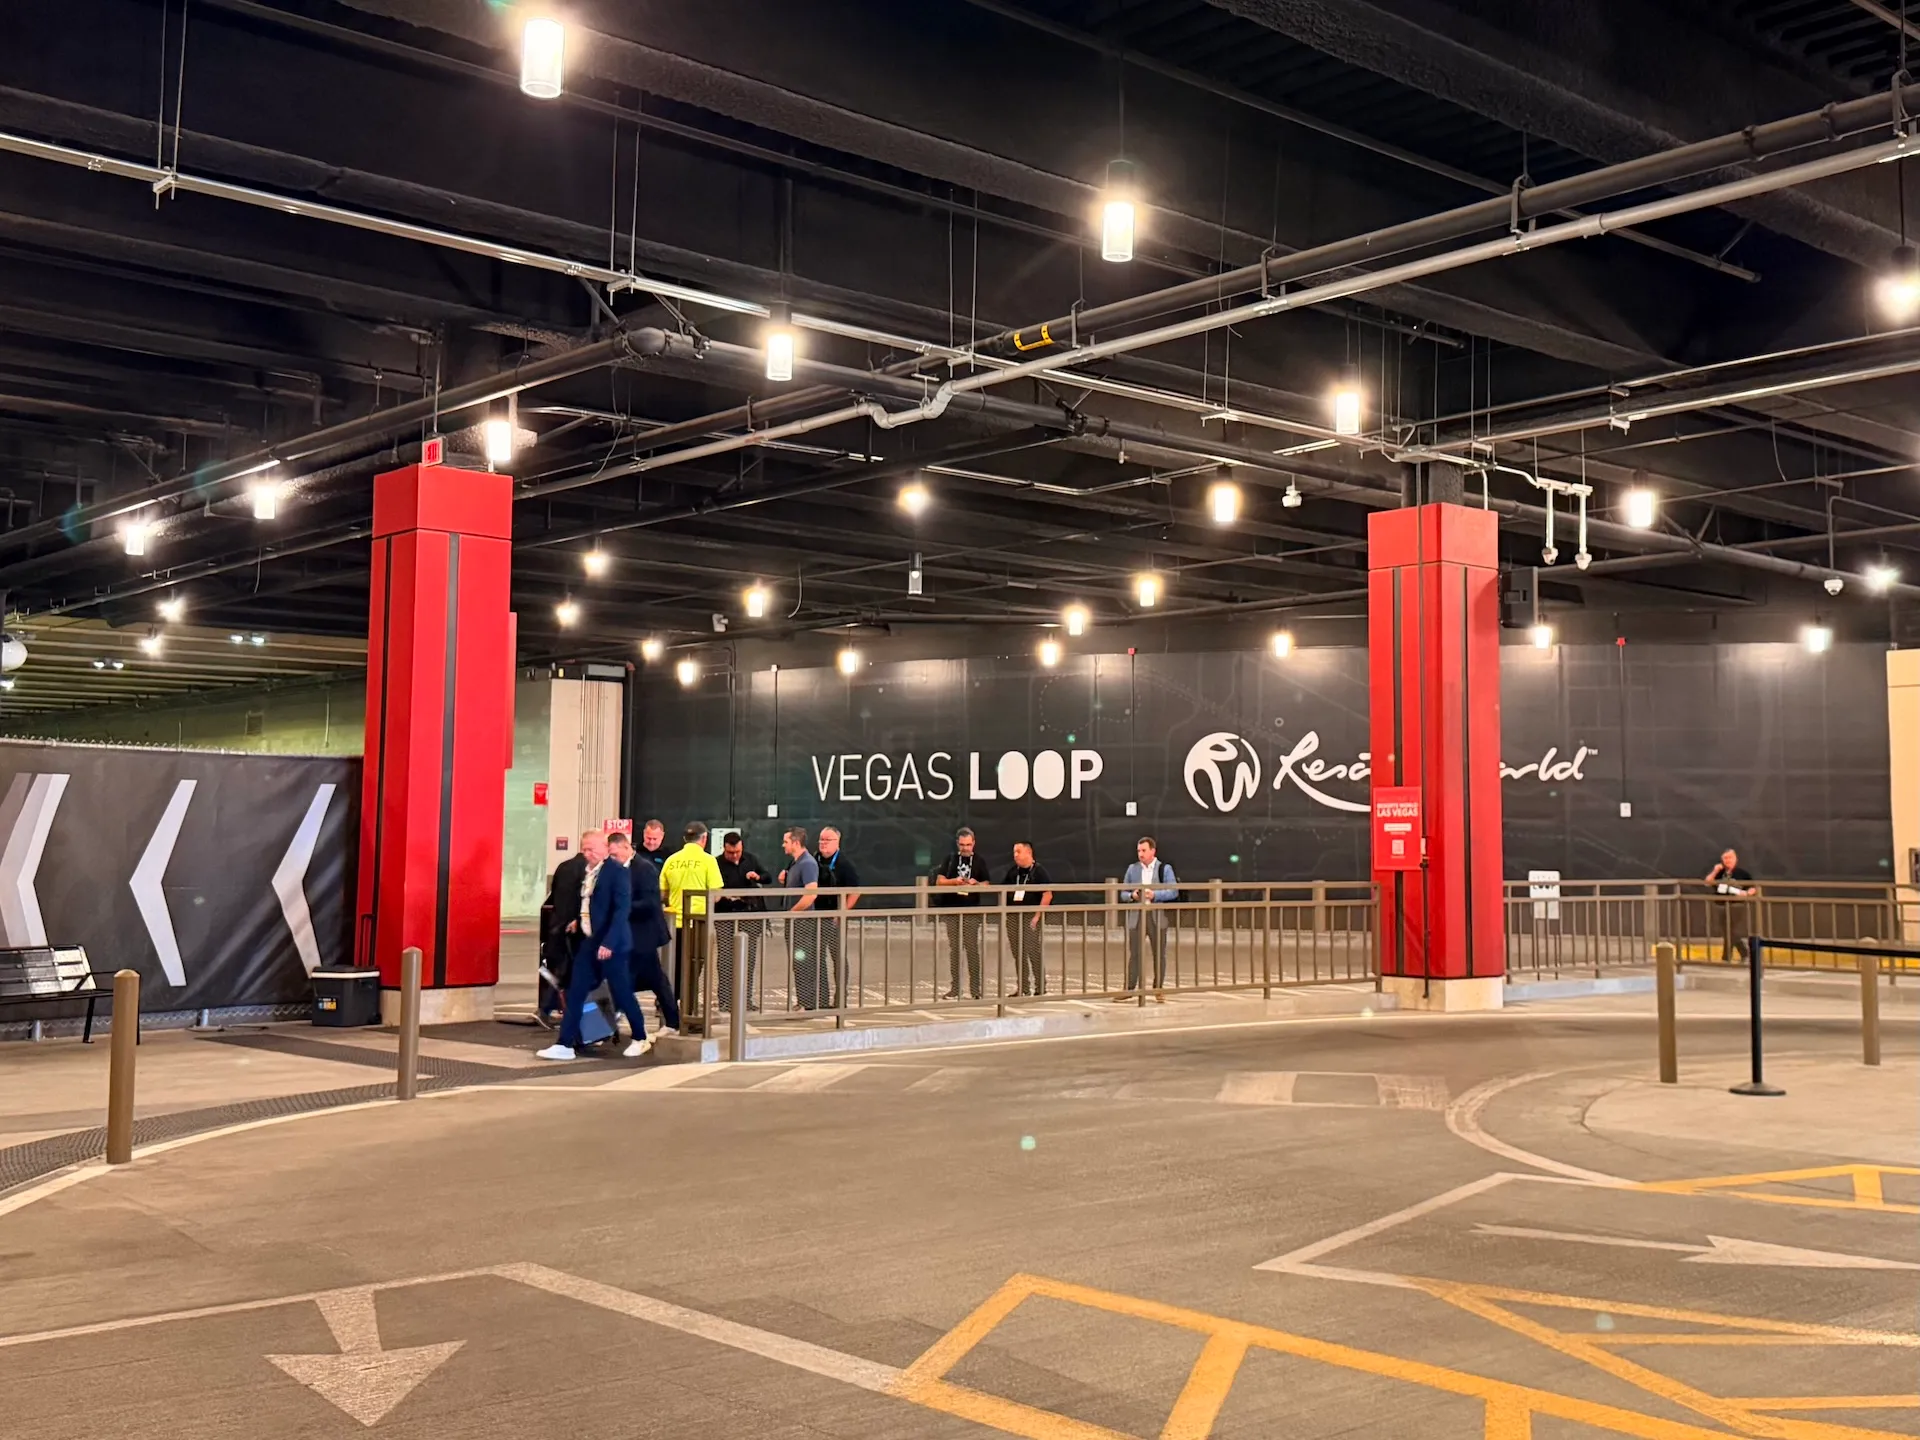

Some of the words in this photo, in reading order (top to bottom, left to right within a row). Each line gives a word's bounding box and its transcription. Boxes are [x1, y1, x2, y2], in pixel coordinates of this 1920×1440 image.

[811, 751, 954, 801] VEGAS
[969, 749, 1103, 800] LOOP
[1376, 807, 1391, 817] LAS
[1391, 807, 1418, 817] VEGAS
[607, 819, 629, 829] STOP
[669, 859, 701, 870] STAFF
